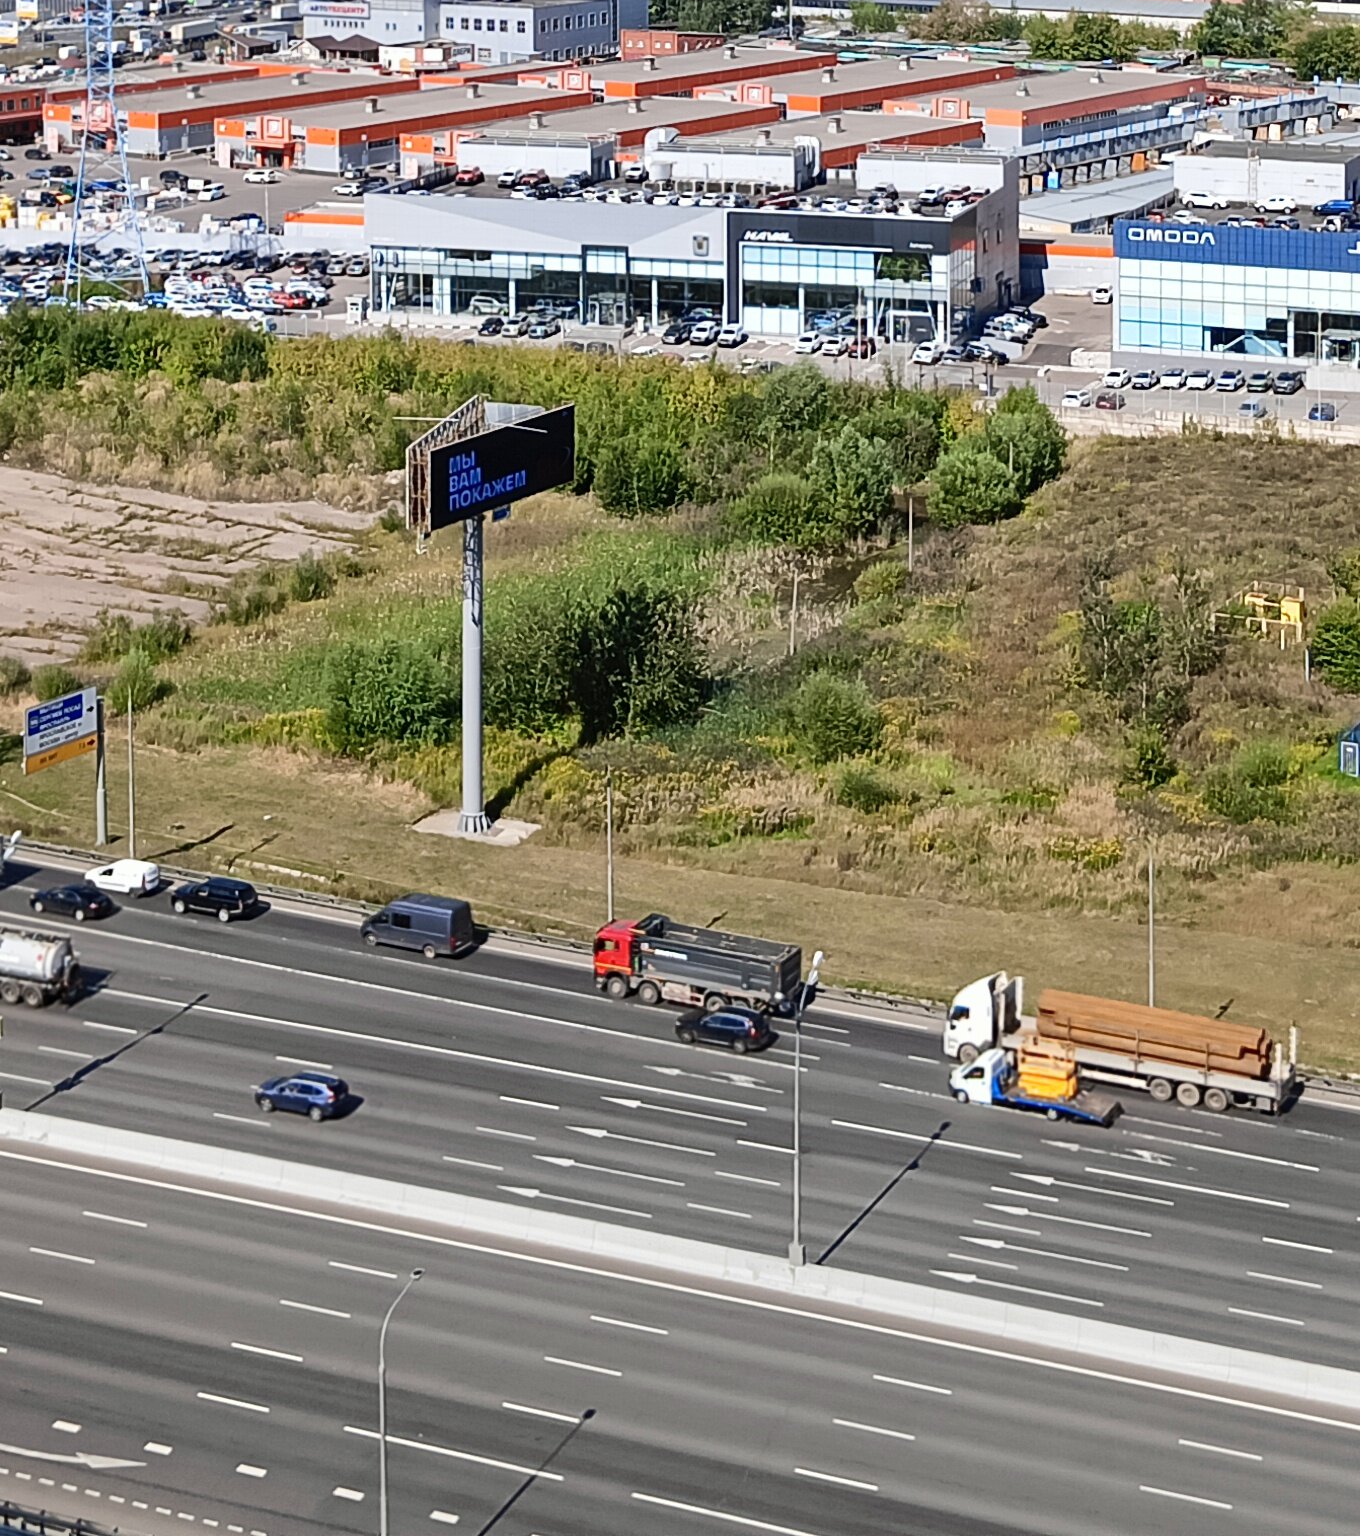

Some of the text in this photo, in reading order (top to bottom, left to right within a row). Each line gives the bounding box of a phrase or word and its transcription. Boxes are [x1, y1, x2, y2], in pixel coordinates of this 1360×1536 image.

[1128, 228, 1216, 245] OMODA
[449, 451, 475, 474] МЫ
[449, 467, 481, 492] ВАМ
[449, 470, 527, 511] ПОКАЖЕМ
